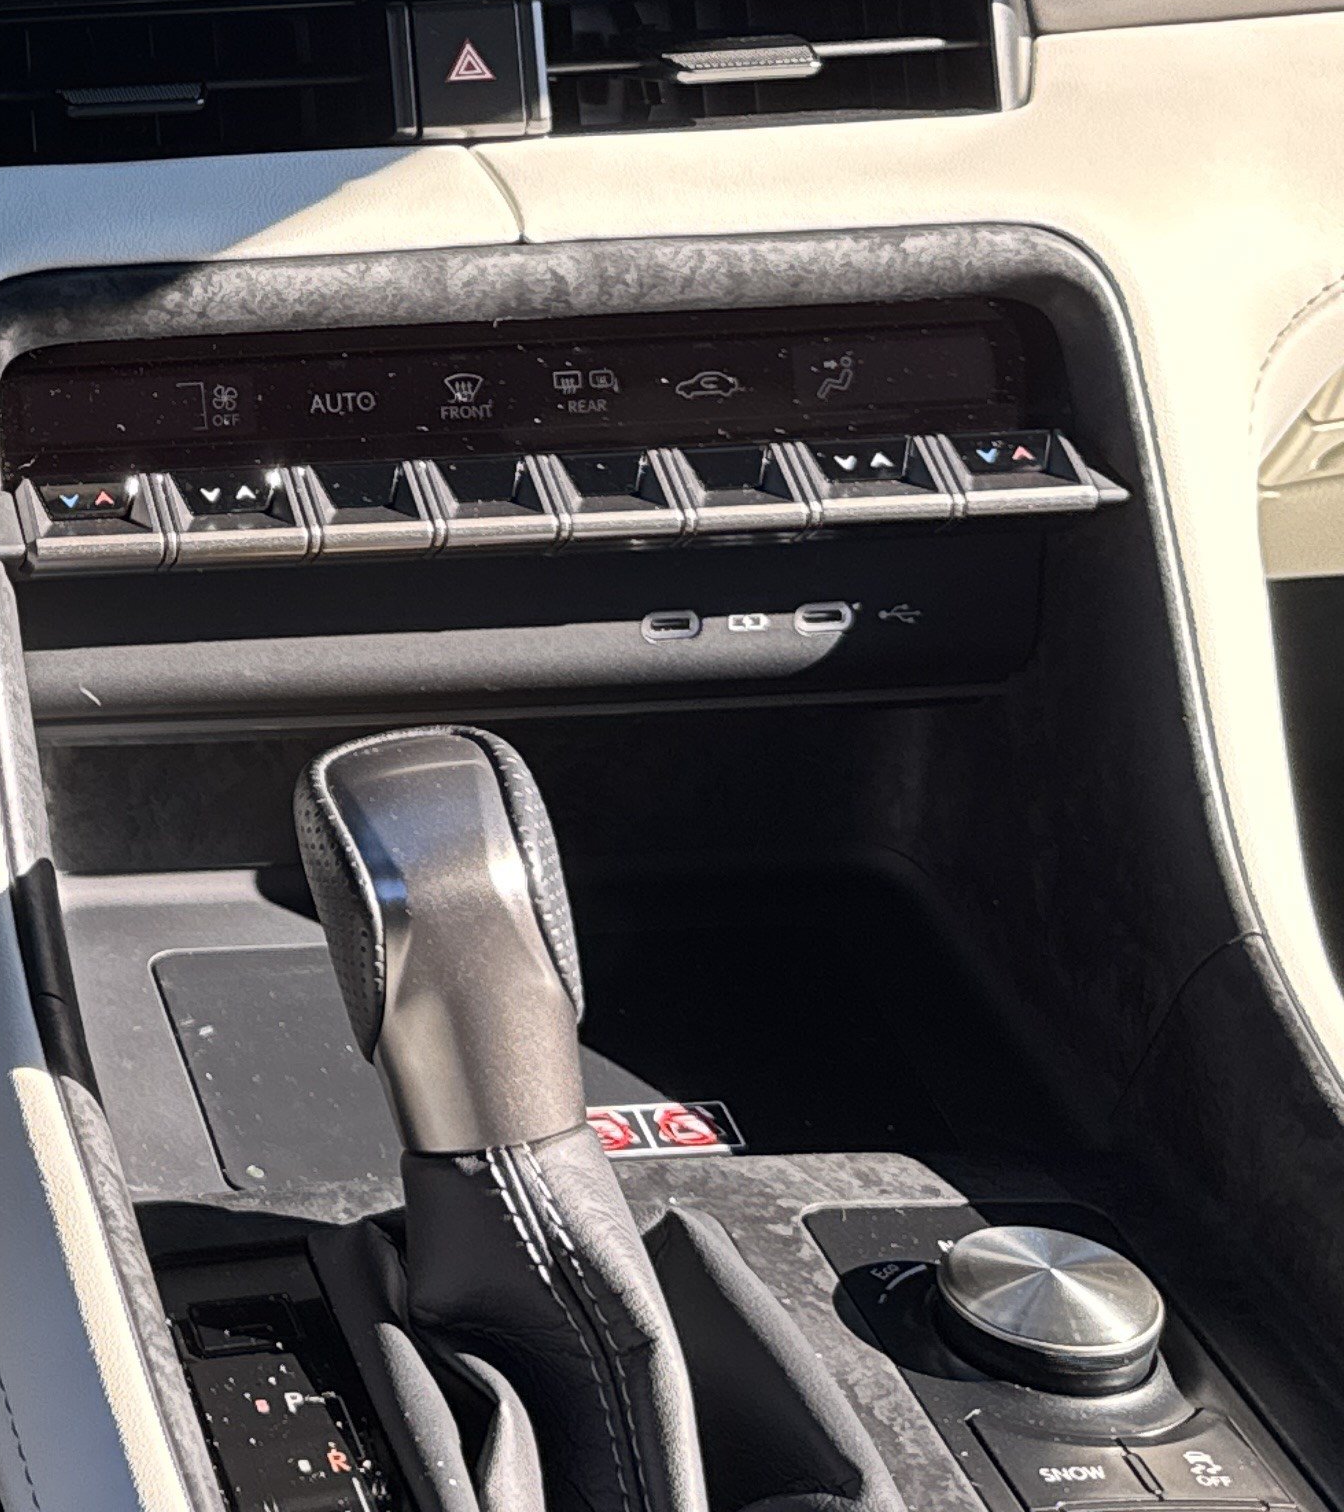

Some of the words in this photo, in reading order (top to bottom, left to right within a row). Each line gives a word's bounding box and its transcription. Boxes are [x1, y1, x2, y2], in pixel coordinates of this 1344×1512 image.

[309, 390, 378, 416] AUTO
[440, 401, 493, 420] FRONT
[567, 397, 608, 416] REAR
[213, 413, 241, 428] OFF
[869, 1263, 900, 1281] Eco
[283, 1391, 305, 1414] P
[326, 1448, 352, 1473] R
[1038, 1464, 1106, 1484] SNOW
[1195, 1473, 1233, 1488] OFF
